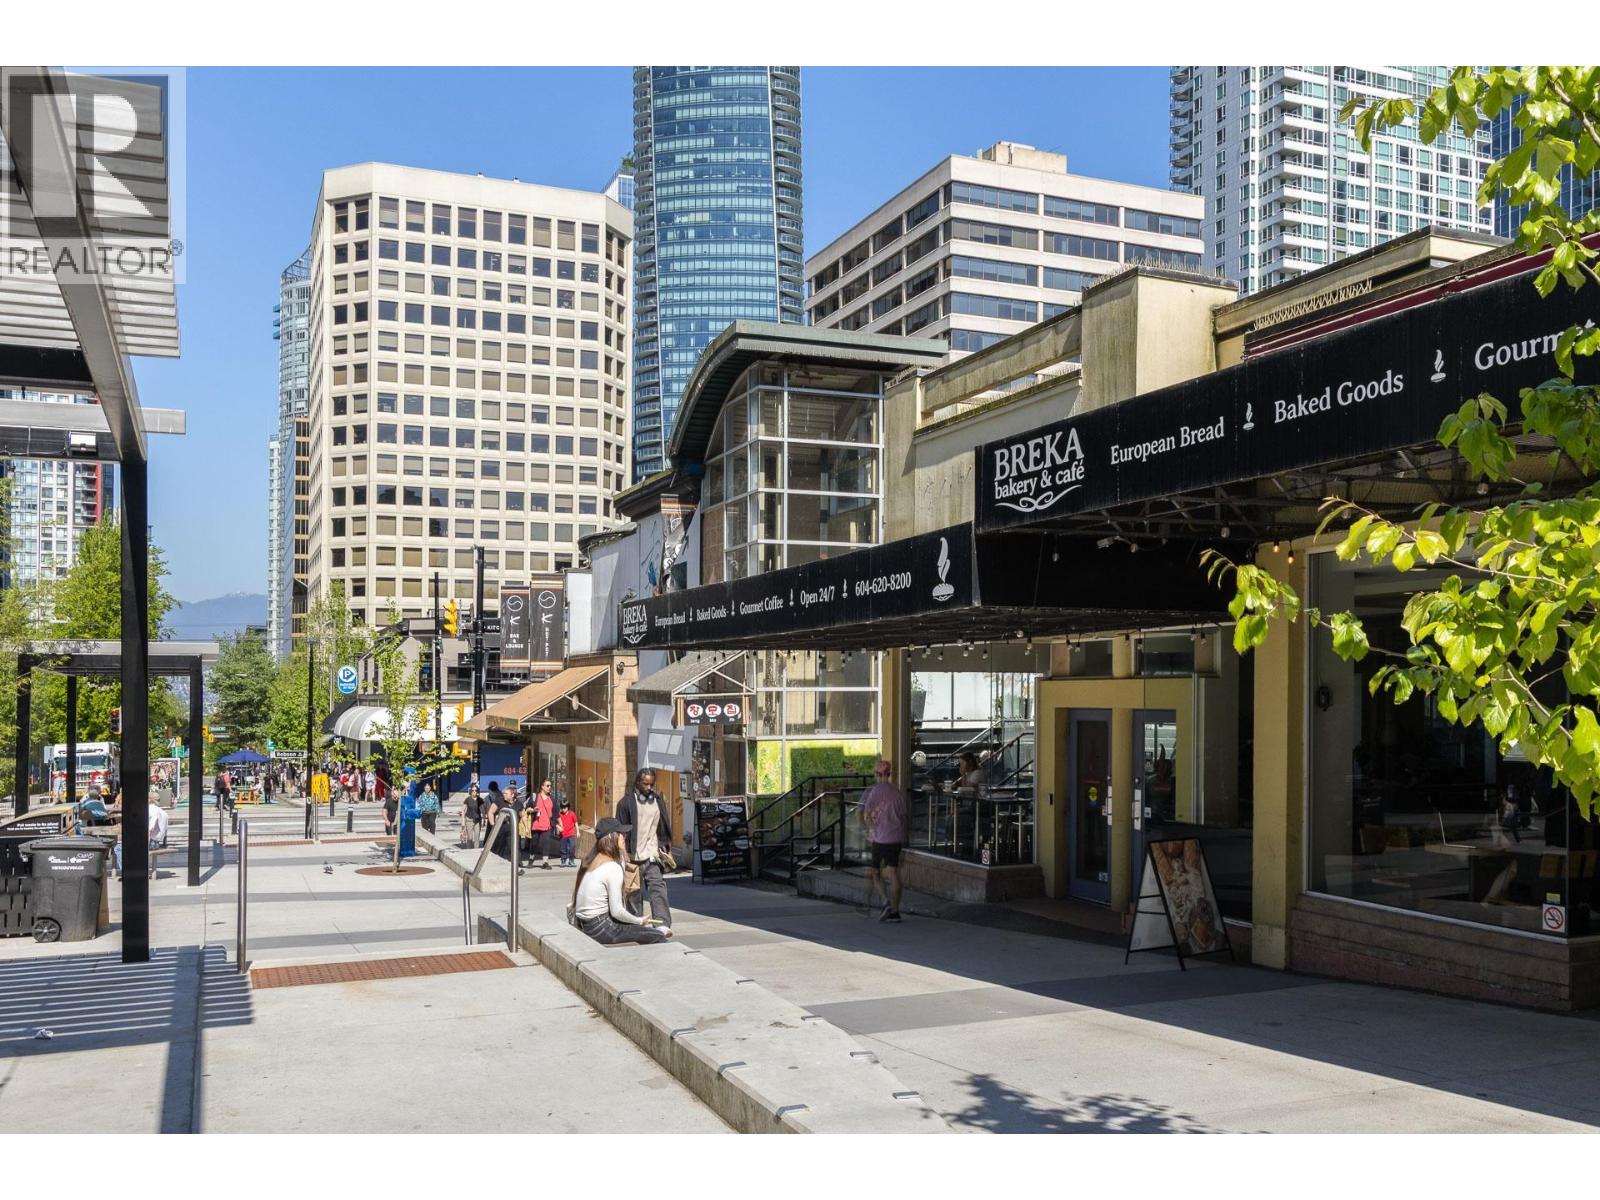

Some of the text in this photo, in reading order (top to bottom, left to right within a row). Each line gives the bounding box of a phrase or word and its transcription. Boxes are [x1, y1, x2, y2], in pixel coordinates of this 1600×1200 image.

[1110, 319, 1599, 464] European Bread Baked Goods Gourm
[994, 427, 1085, 482] BREKA
[994, 459, 1085, 500] bakery & café
[623, 604, 648, 625] BREKA
[654, 571, 912, 629] European Bread Baked Goods Gourmet Coffee Open 24/7 604-620-8200
